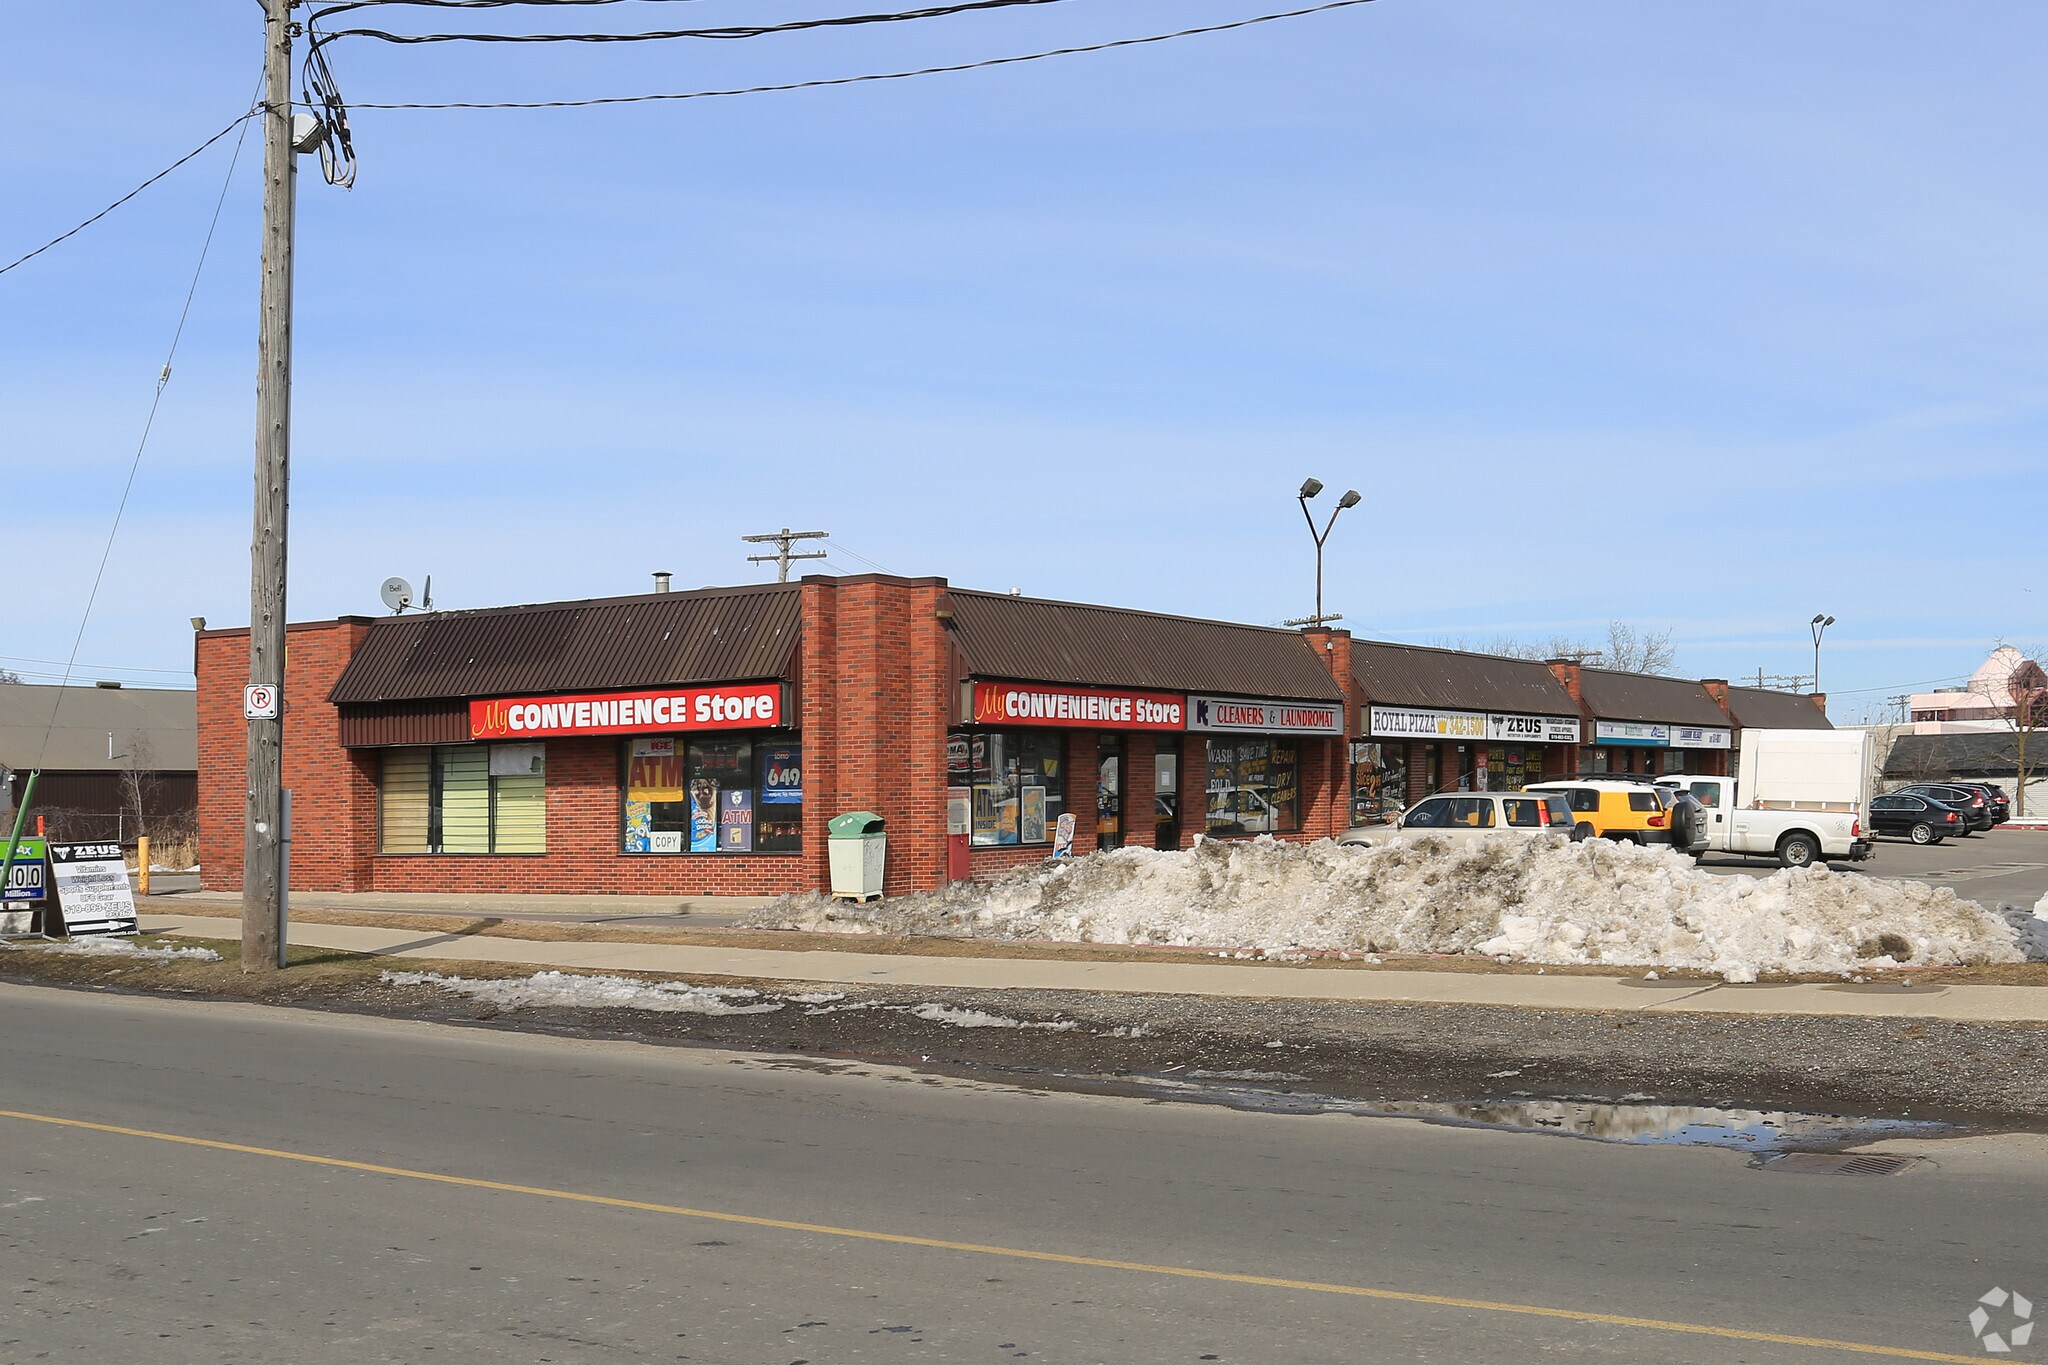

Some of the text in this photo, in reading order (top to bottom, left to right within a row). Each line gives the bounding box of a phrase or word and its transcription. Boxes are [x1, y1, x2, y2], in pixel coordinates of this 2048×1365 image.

[974, 685, 1180, 724] My CONVENIENCE Store
[472, 694, 774, 736] My CONVENIENCE Store
[1217, 705, 1264, 726] CLEANERS
[1280, 709, 1335, 728] LAUNDROMAT
[1374, 711, 1485, 736] ROYAL PIZZA 342-1500
[1507, 717, 1541, 733] ZEUS
[651, 740, 673, 750] ICE
[1208, 749, 1232, 763] WASH
[1272, 750, 1295, 764] REPAIR
[629, 755, 683, 788] ATM
[1210, 779, 1231, 794] FOLD
[1276, 771, 1292, 788] DRY
[721, 809, 752, 824] ATM
[975, 820, 996, 829] INSIDE
[655, 836, 677, 848] COPY
[73, 845, 122, 856] ZEUS
[75, 865, 107, 874] Vitamins
[71, 874, 115, 885] Weight Loss
[5, 890, 30, 898] Million
[59, 882, 130, 895] Sports Supplements
[80, 893, 115, 903] UFC Gear
[64, 900, 132, 915] 519-893-ZEUS
